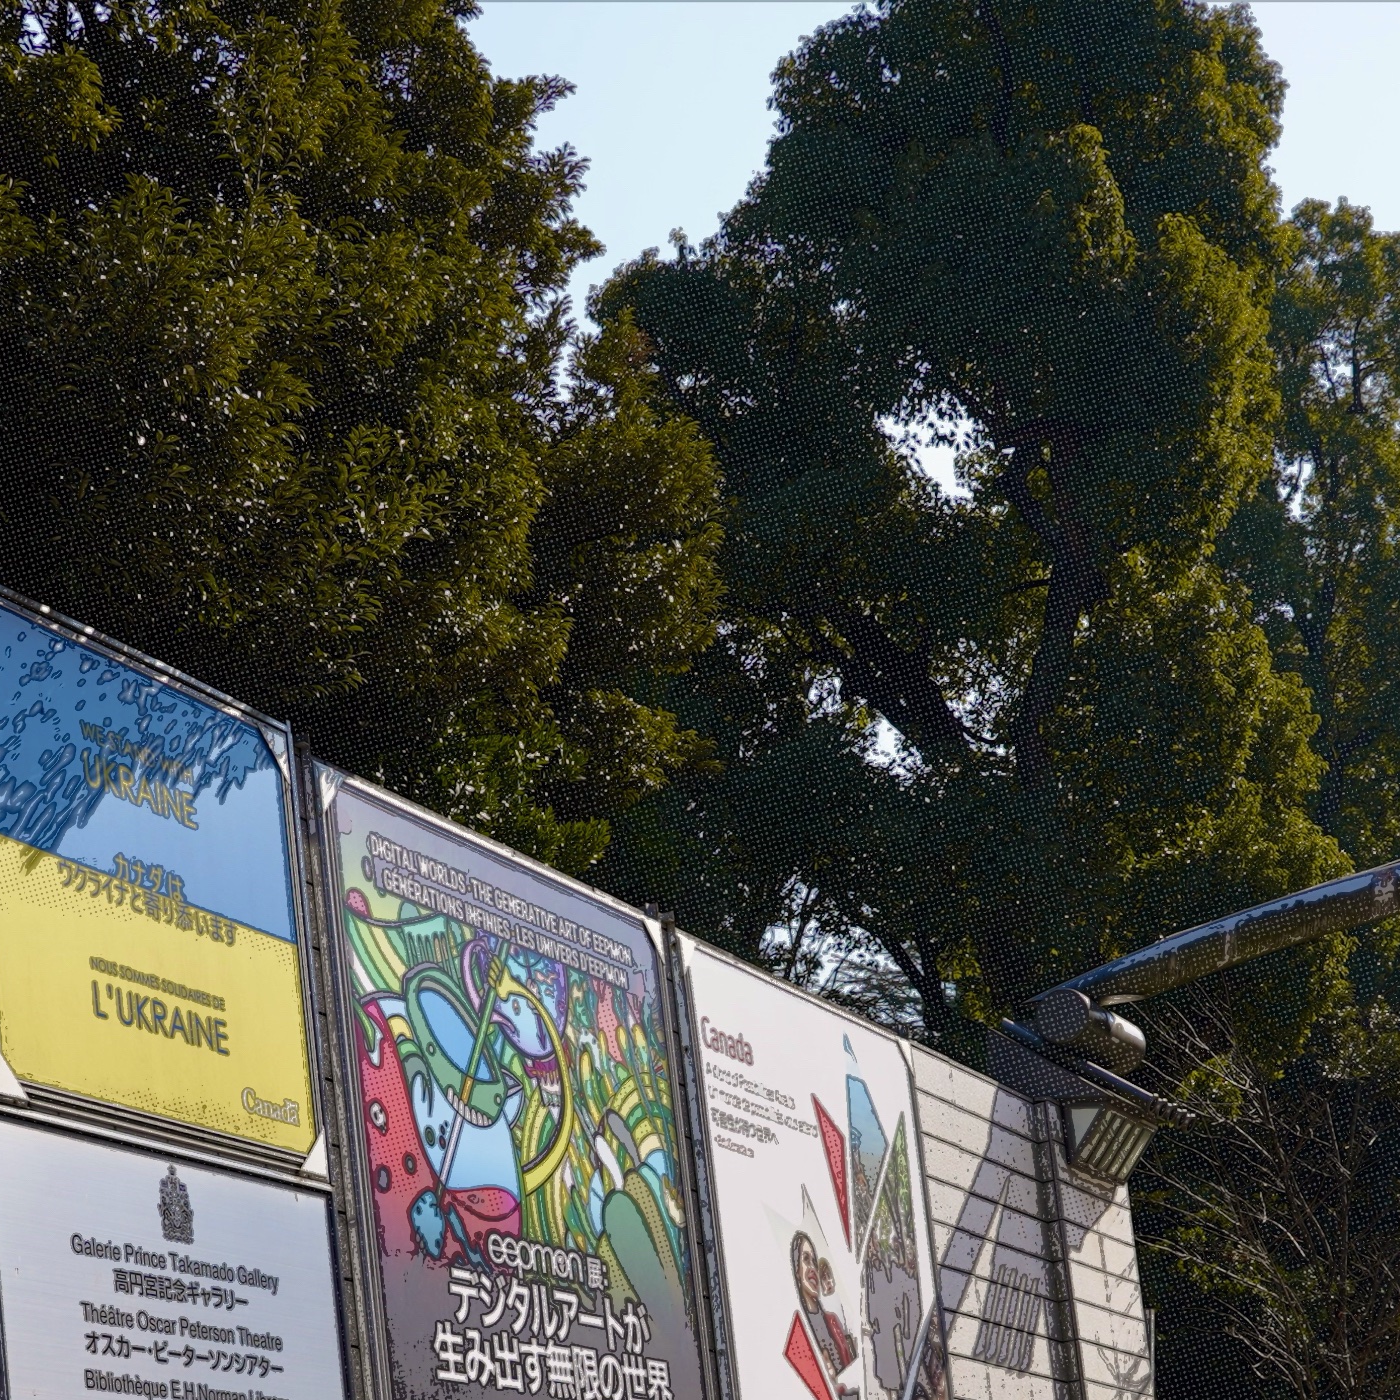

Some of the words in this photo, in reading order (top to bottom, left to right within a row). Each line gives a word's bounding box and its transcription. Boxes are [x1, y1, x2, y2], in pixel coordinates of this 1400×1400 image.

[82, 748, 199, 830] UKRAINE
[113, 852, 187, 904] カナダは
[368, 832, 417, 874] DIGITAL
[417, 855, 467, 895] WORLDS
[470, 878, 494, 904] THE
[494, 888, 558, 934] GENERATIVE
[558, 918, 579, 942] ART
[579, 928, 592, 948] OF
[592, 934, 633, 968] EEPMON
[515, 924, 535, 951] LES
[535, 931, 579, 970] UNIVERS
[90, 956, 118, 977] NOUS
[119, 965, 160, 990] SOMMES
[161, 978, 211, 1007] SOLIDAIRES
[212, 995, 227, 1012] DE
[91, 980, 230, 1057] L'UKRAINE
[700, 1016, 754, 1067] Canada
[241, 1087, 300, 1127] Canada
[70, 1232, 121, 1263] Galerie
[123, 1243, 167, 1270] Prince
[168, 1251, 234, 1283] Takamado
[237, 1265, 279, 1295] Gallery
[113, 1268, 249, 1311] 高円宮記念ギャラリー
[79, 1300, 134, 1329] Théâtre
[137, 1310, 176, 1335] Oscar
[179, 1316, 235, 1345] Peterson
[236, 1325, 284, 1351] Theatre
[448, 1267, 652, 1355] デジタルアートが
